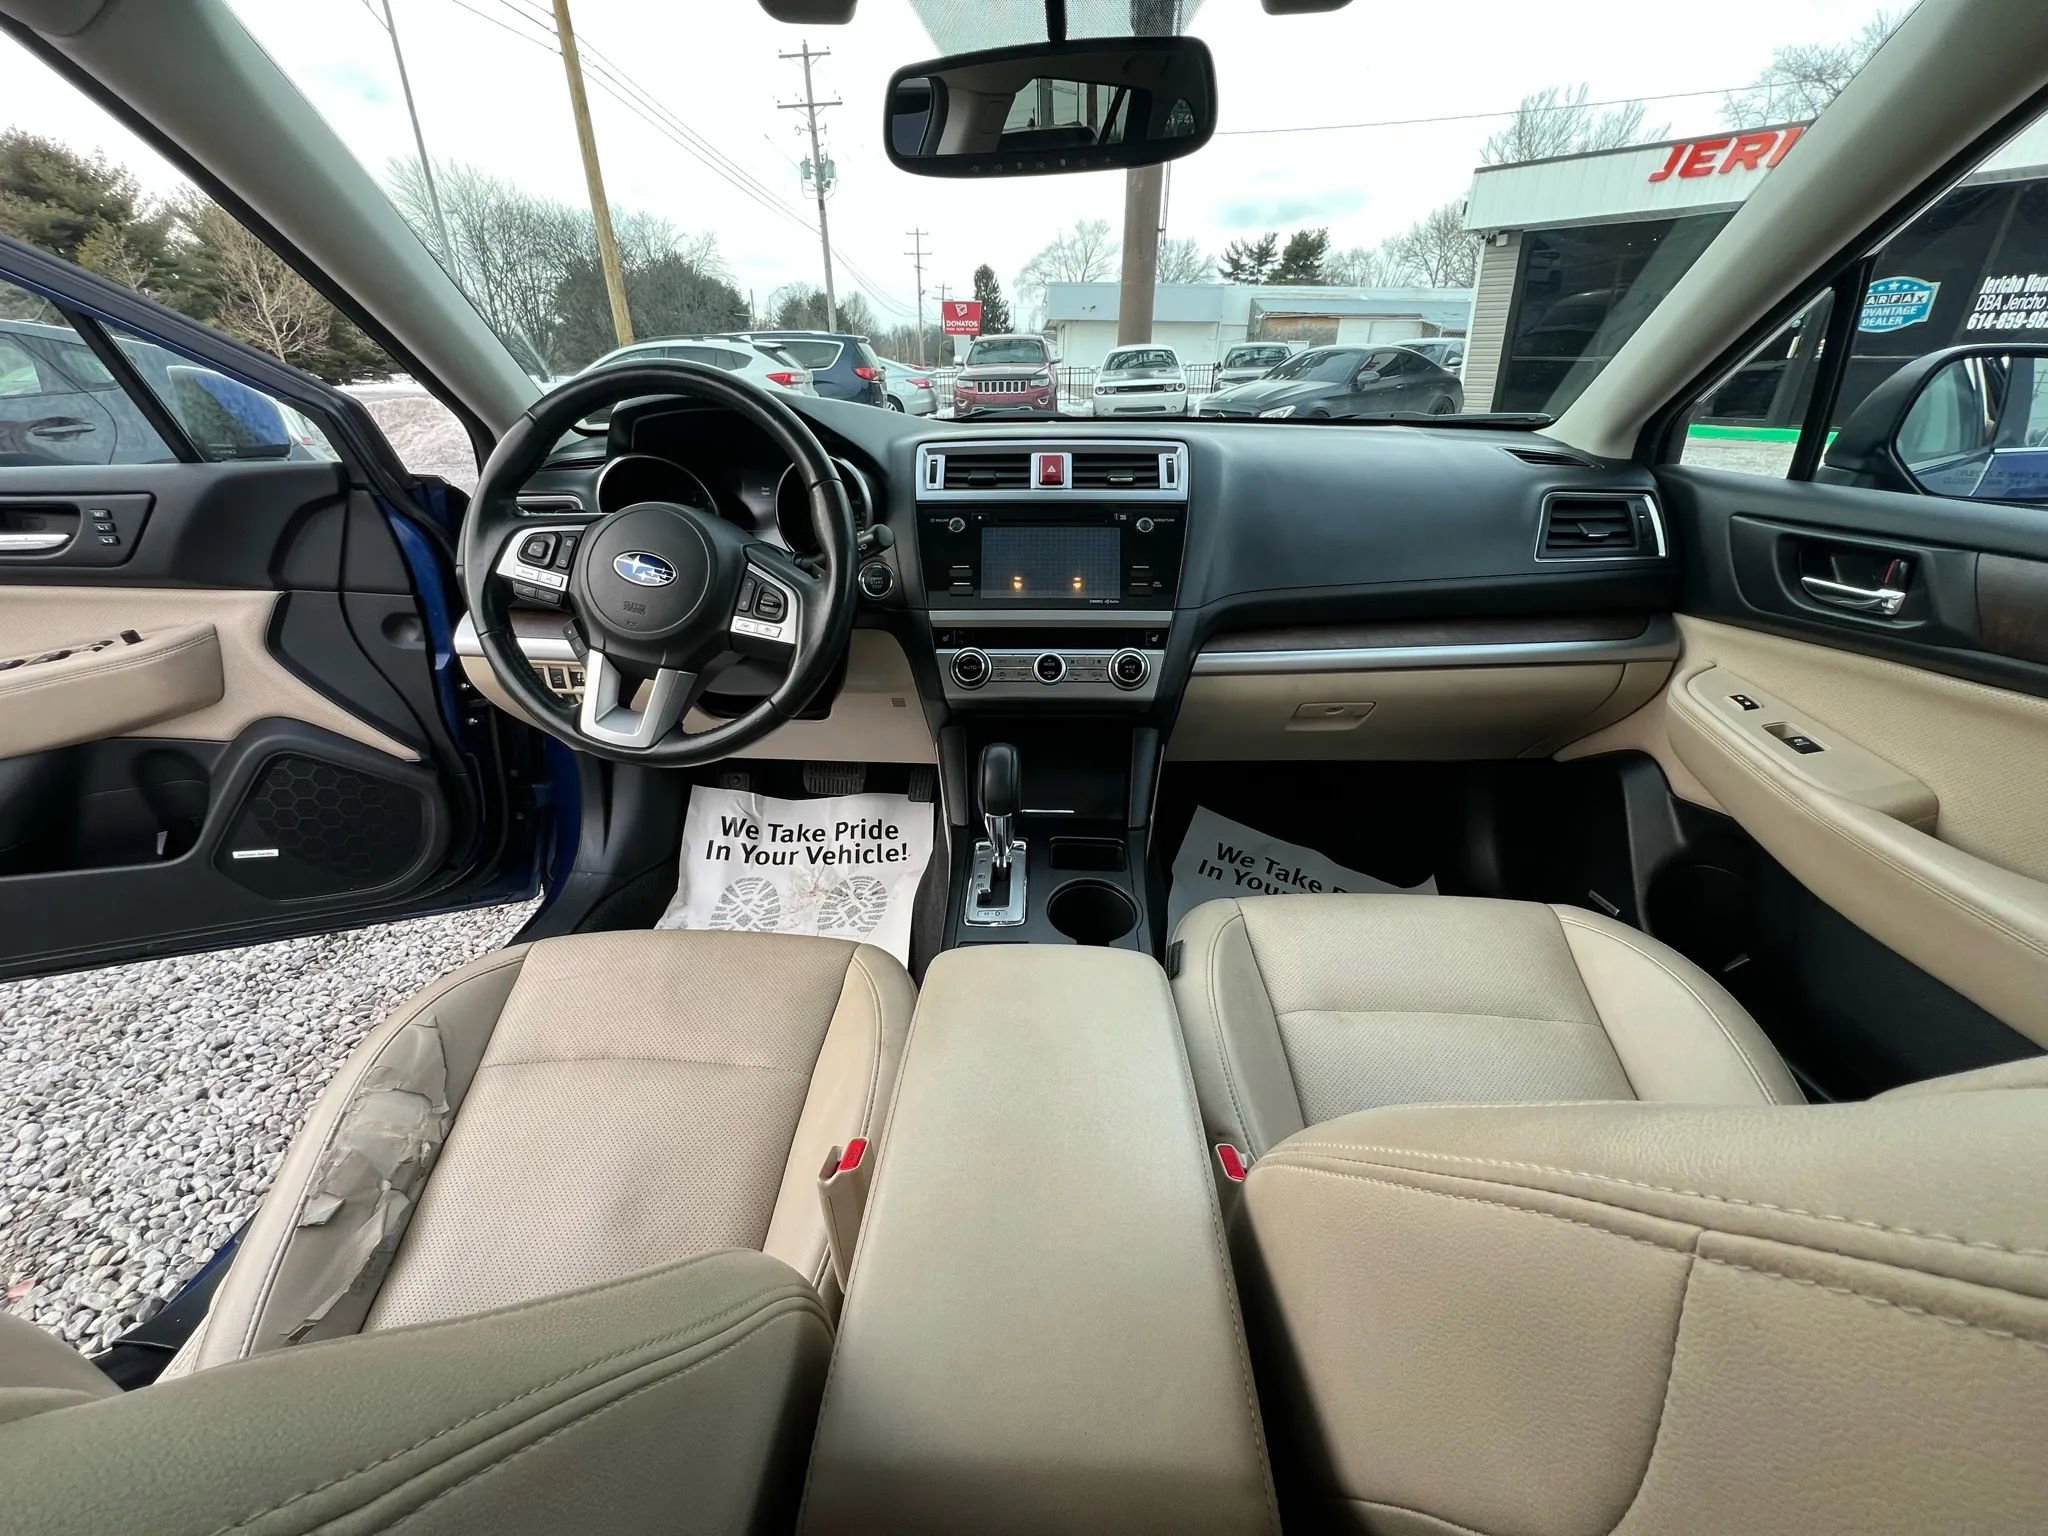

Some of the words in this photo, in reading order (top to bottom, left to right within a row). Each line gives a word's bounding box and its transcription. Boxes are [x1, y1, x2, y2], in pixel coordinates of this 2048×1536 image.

[1648, 127, 1804, 182] JERI
[1979, 275, 2025, 294] Jericho
[1974, 294, 2003, 311] DBA
[2002, 293, 2047, 310] Jericho
[1862, 317, 1903, 327] DEALER
[721, 816, 759, 840] We
[767, 823, 826, 843] Take
[835, 818, 899, 842] Pride
[705, 840, 731, 861] In
[740, 843, 800, 866] Your
[806, 842, 908, 866] Vehicle!
[1198, 859, 1223, 881] In
[1233, 868, 1303, 895] You
[1217, 842, 1255, 868] We
[1264, 856, 1323, 894] Take
